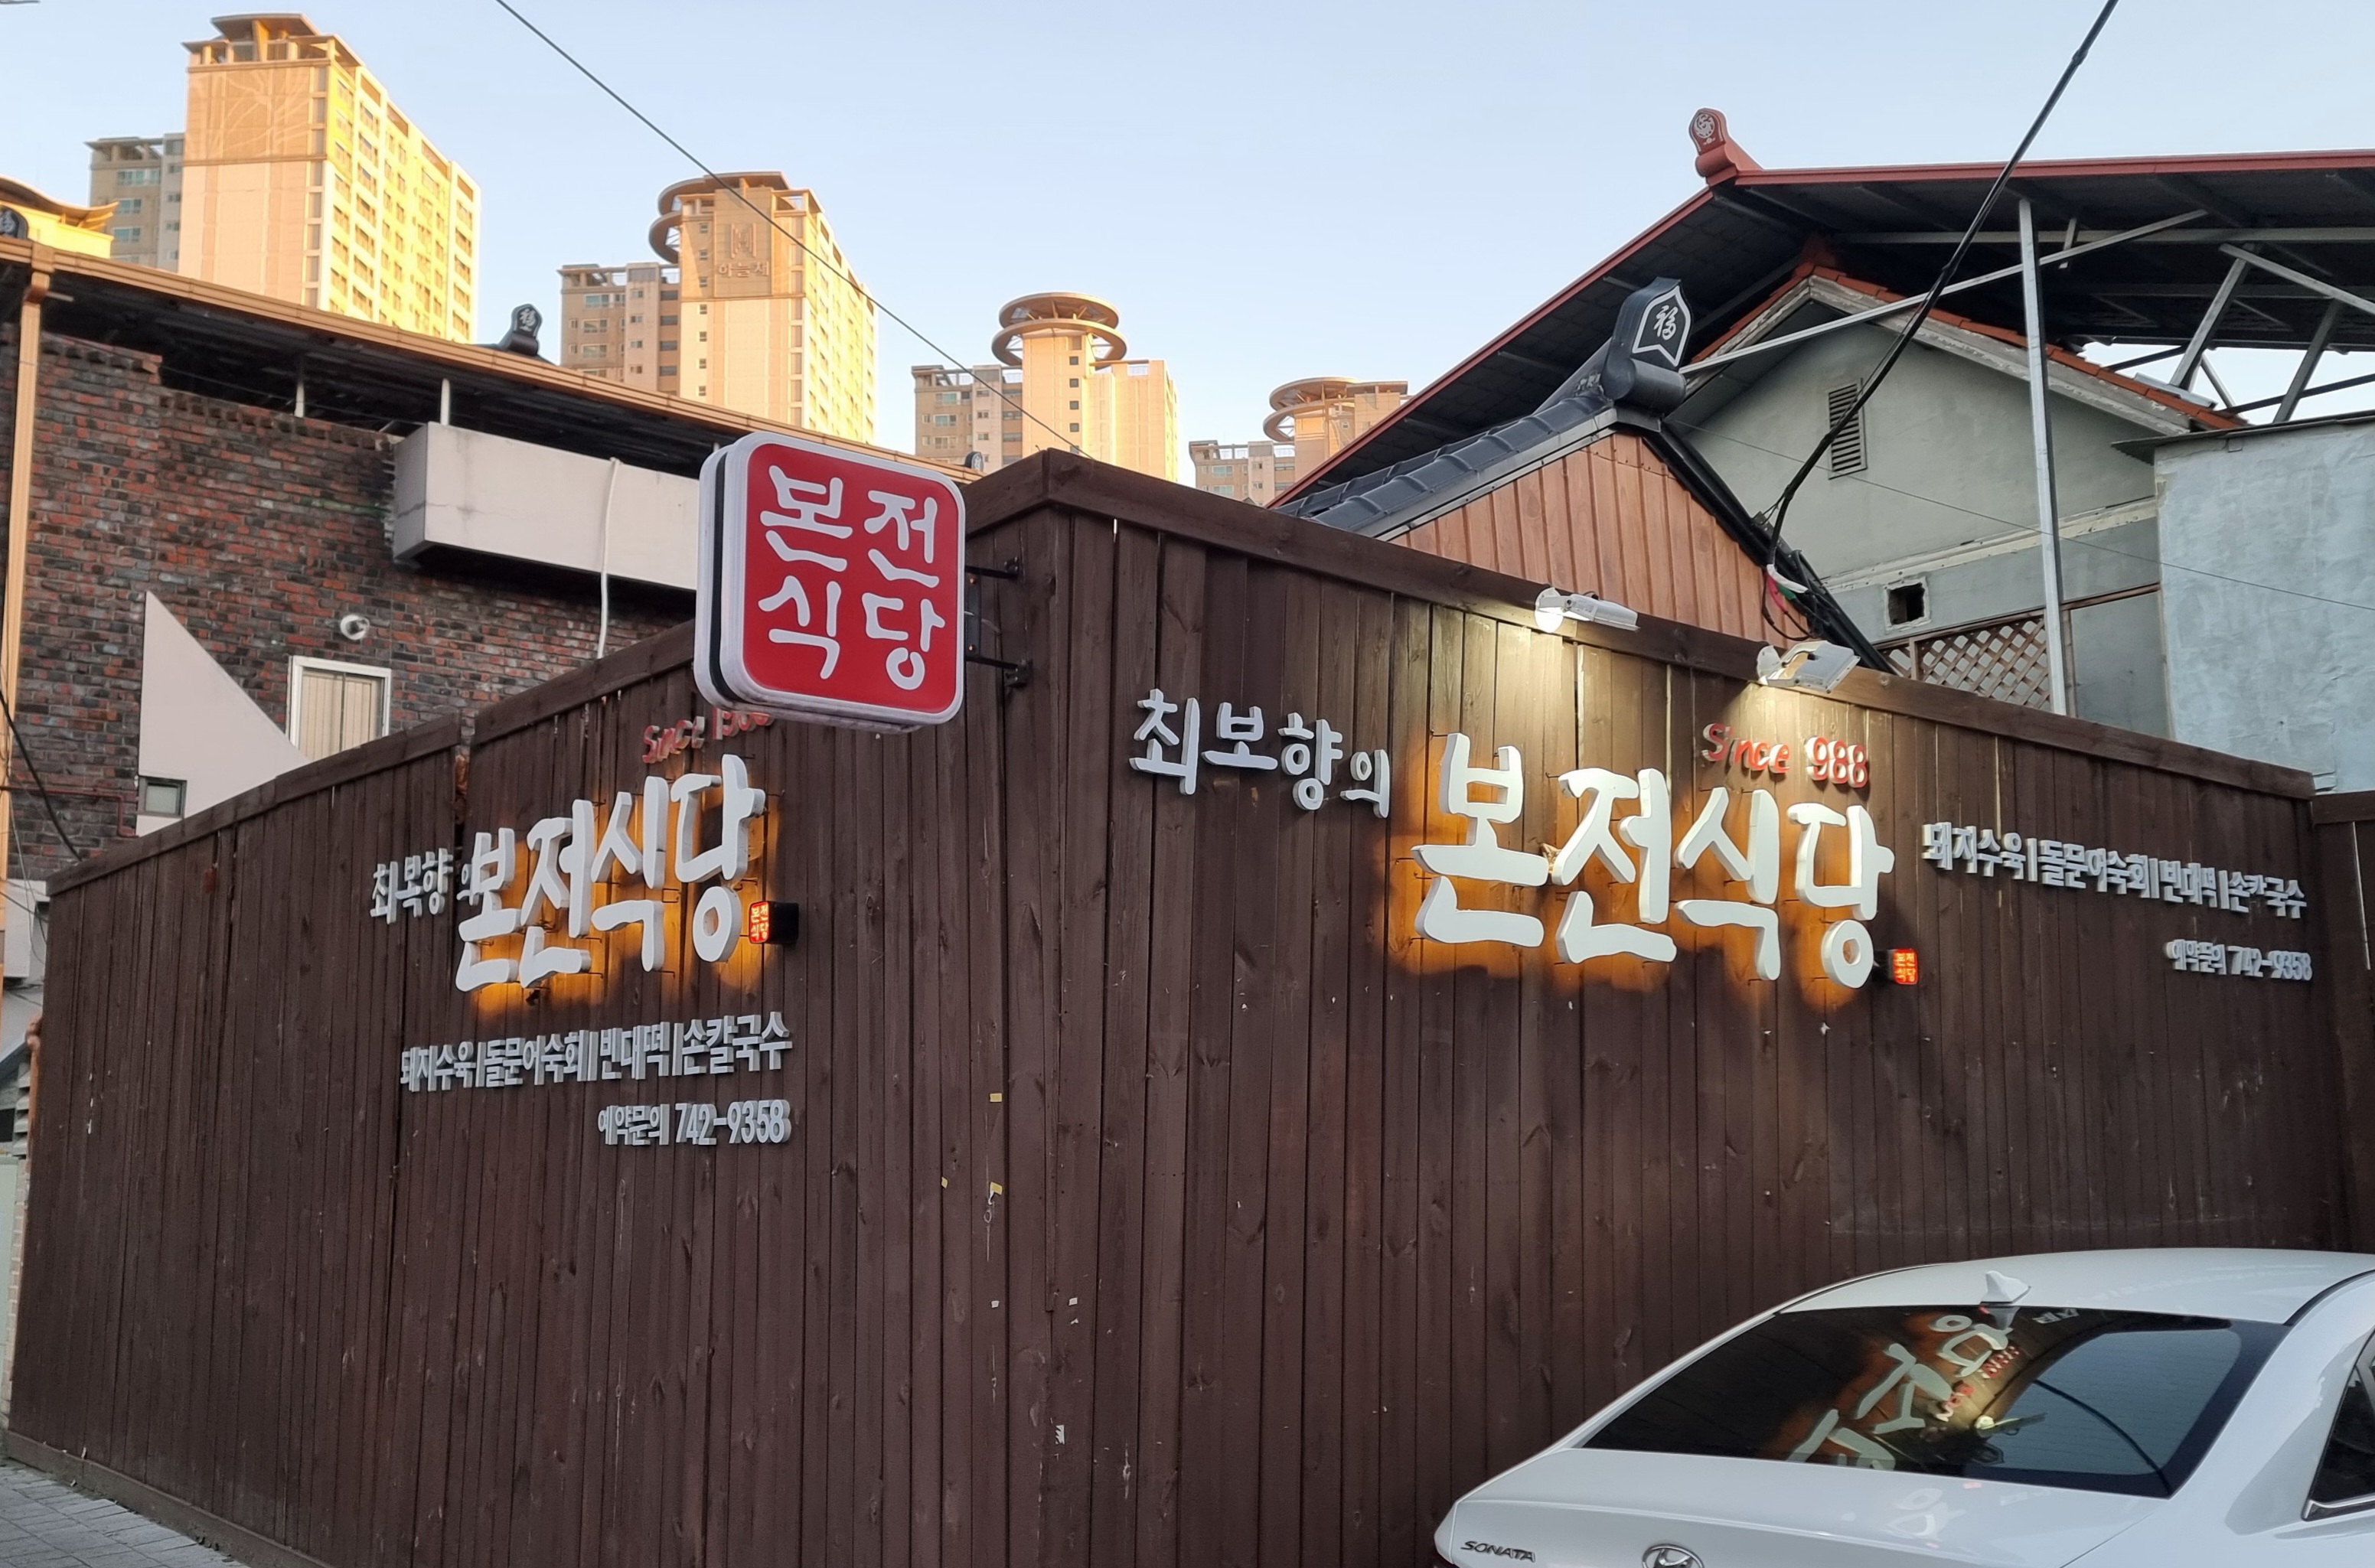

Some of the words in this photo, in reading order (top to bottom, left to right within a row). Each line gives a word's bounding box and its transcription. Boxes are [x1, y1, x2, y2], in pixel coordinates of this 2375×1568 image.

[760, 465, 940, 588] 본전
[758, 575, 945, 691] 식당
[1701, 722, 1792, 774] Snce
[1804, 736, 1868, 788] 988
[455, 753, 766, 993] 본전식당
[1411, 732, 1896, 989] 본전식당
[598, 1103, 670, 1146] 예약문의
[674, 1099, 793, 1146] 742-9358
[1460, 1540, 1537, 1563] SONATA
